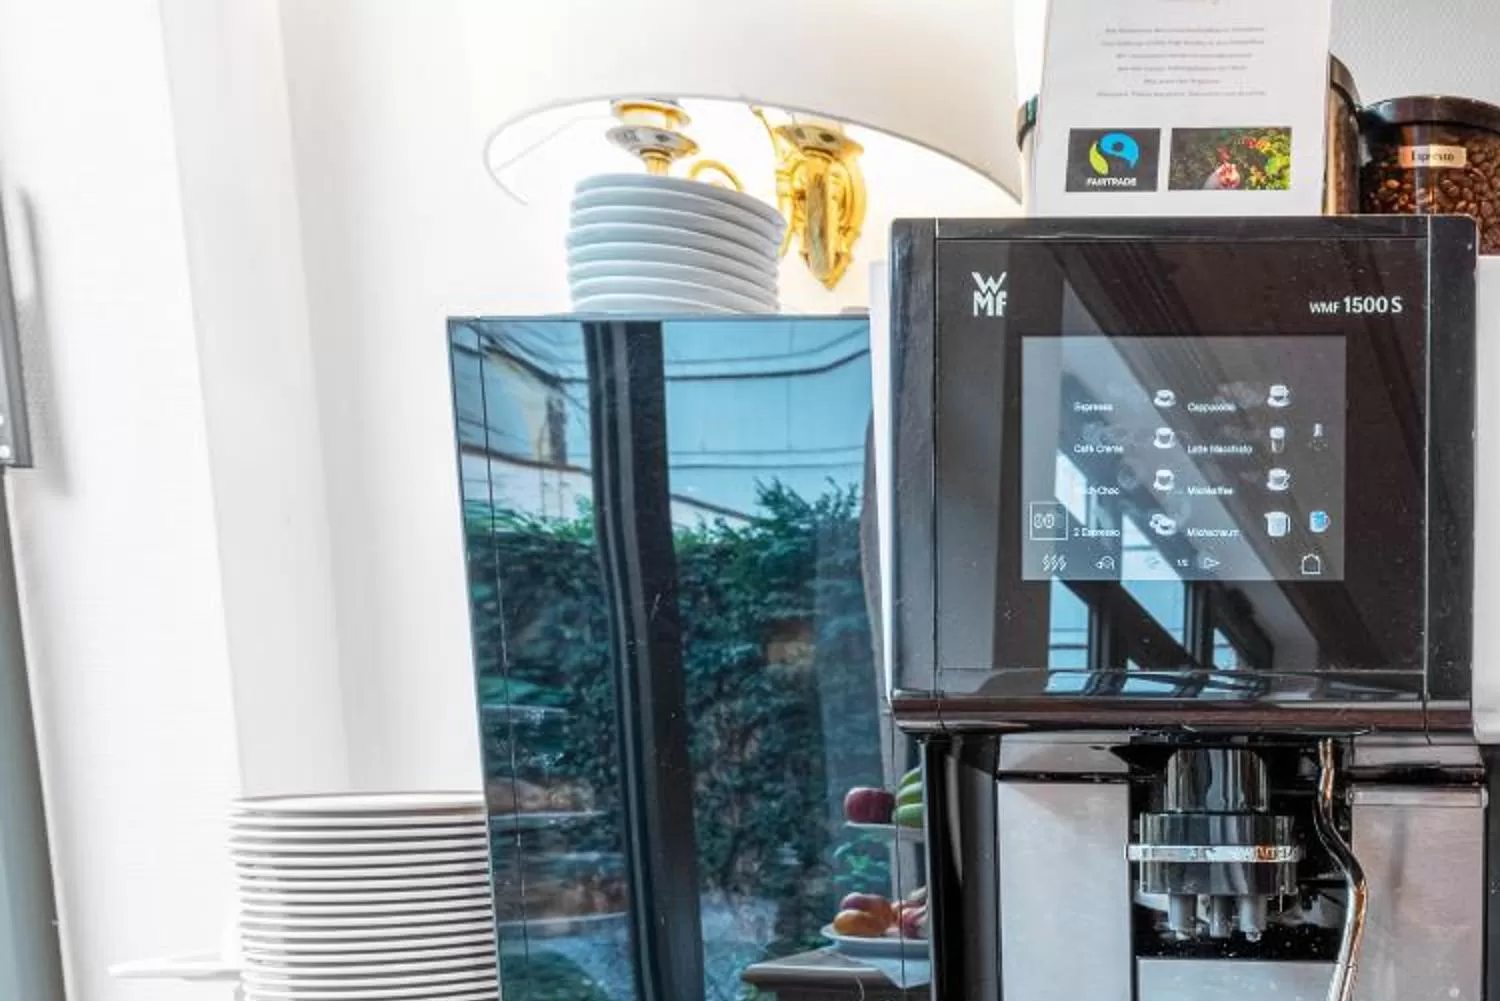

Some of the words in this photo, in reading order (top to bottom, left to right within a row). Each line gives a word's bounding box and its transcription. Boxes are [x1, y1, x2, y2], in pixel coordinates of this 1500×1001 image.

[1309, 301, 1341, 314] WMF
[1344, 295, 1389, 313] 1500
[1391, 295, 1403, 313] S
